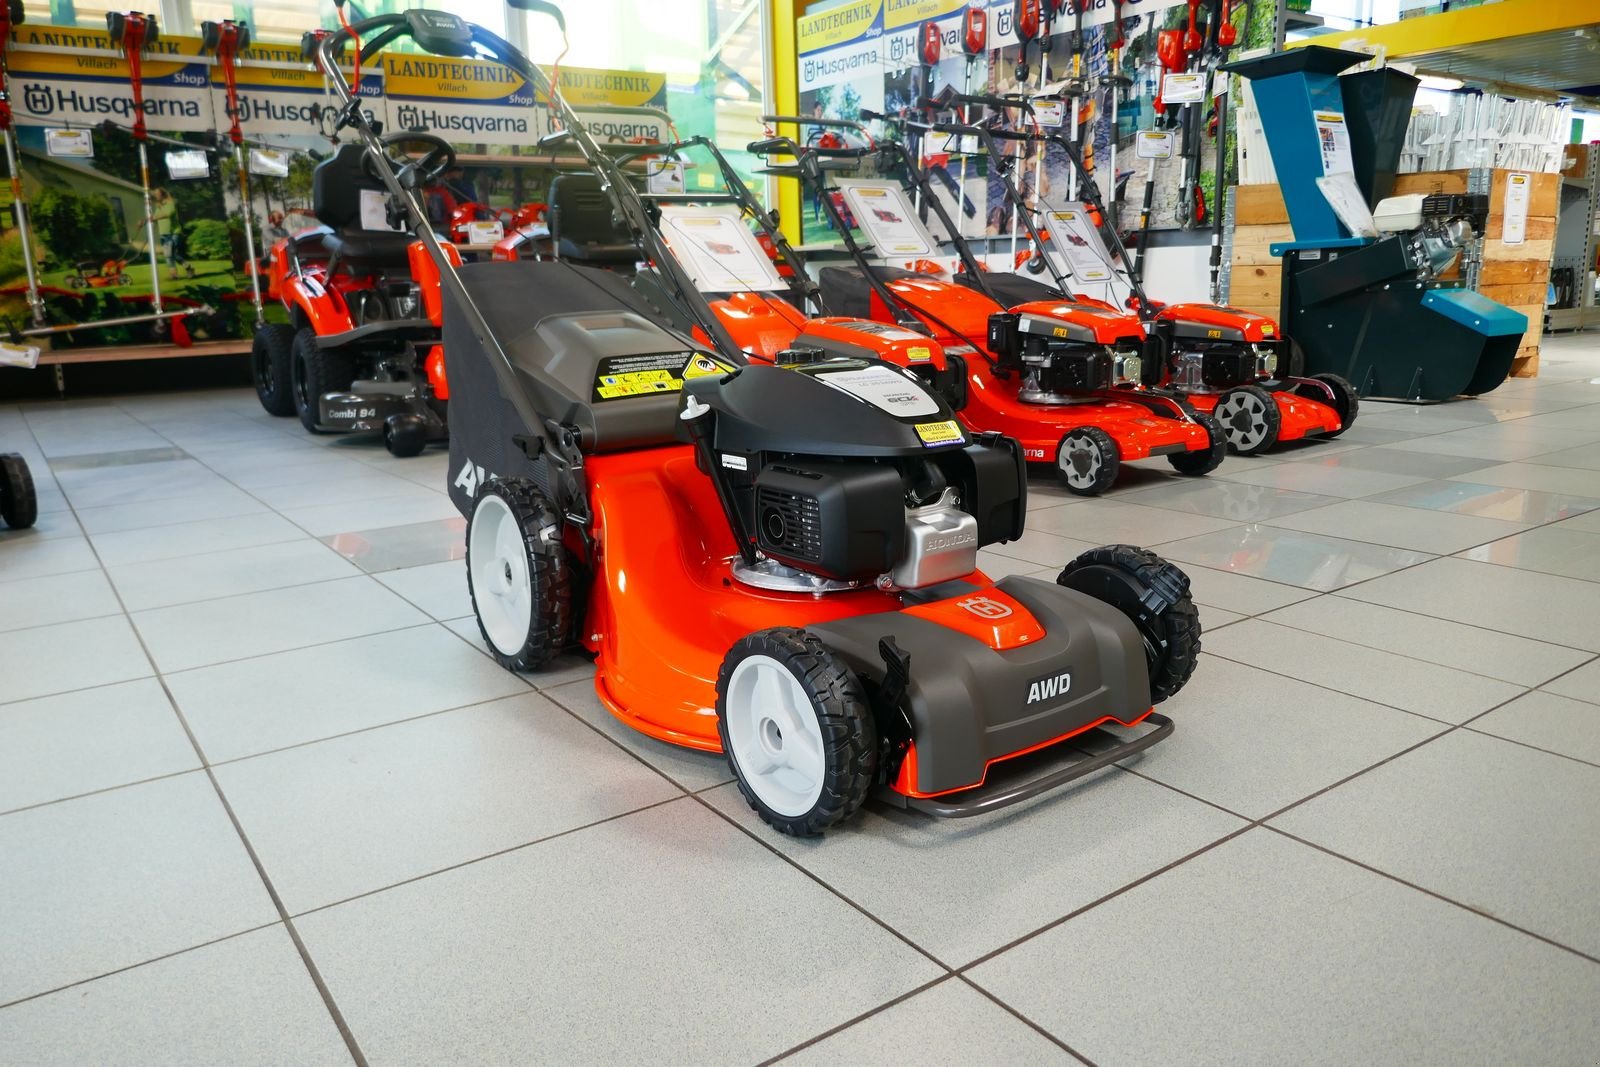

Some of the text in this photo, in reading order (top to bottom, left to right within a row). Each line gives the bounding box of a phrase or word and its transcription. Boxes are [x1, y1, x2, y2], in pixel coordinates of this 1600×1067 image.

[802, 4, 872, 37] LANDTECHNIK
[77, 57, 117, 69] Villach
[389, 60, 517, 83] LANDTECHNIK
[816, 50, 877, 77] Husqvarna
[174, 73, 205, 85] Shop
[437, 82, 468, 92] Villach
[560, 72, 651, 92] NDTECHNIK
[359, 83, 380, 96] hop
[509, 94, 533, 105] Shop
[421, 110, 527, 134] Husqvarna
[328, 408, 376, 418] Combi 94
[926, 533, 976, 551] HONDA
[1027, 673, 1071, 705] AWD
